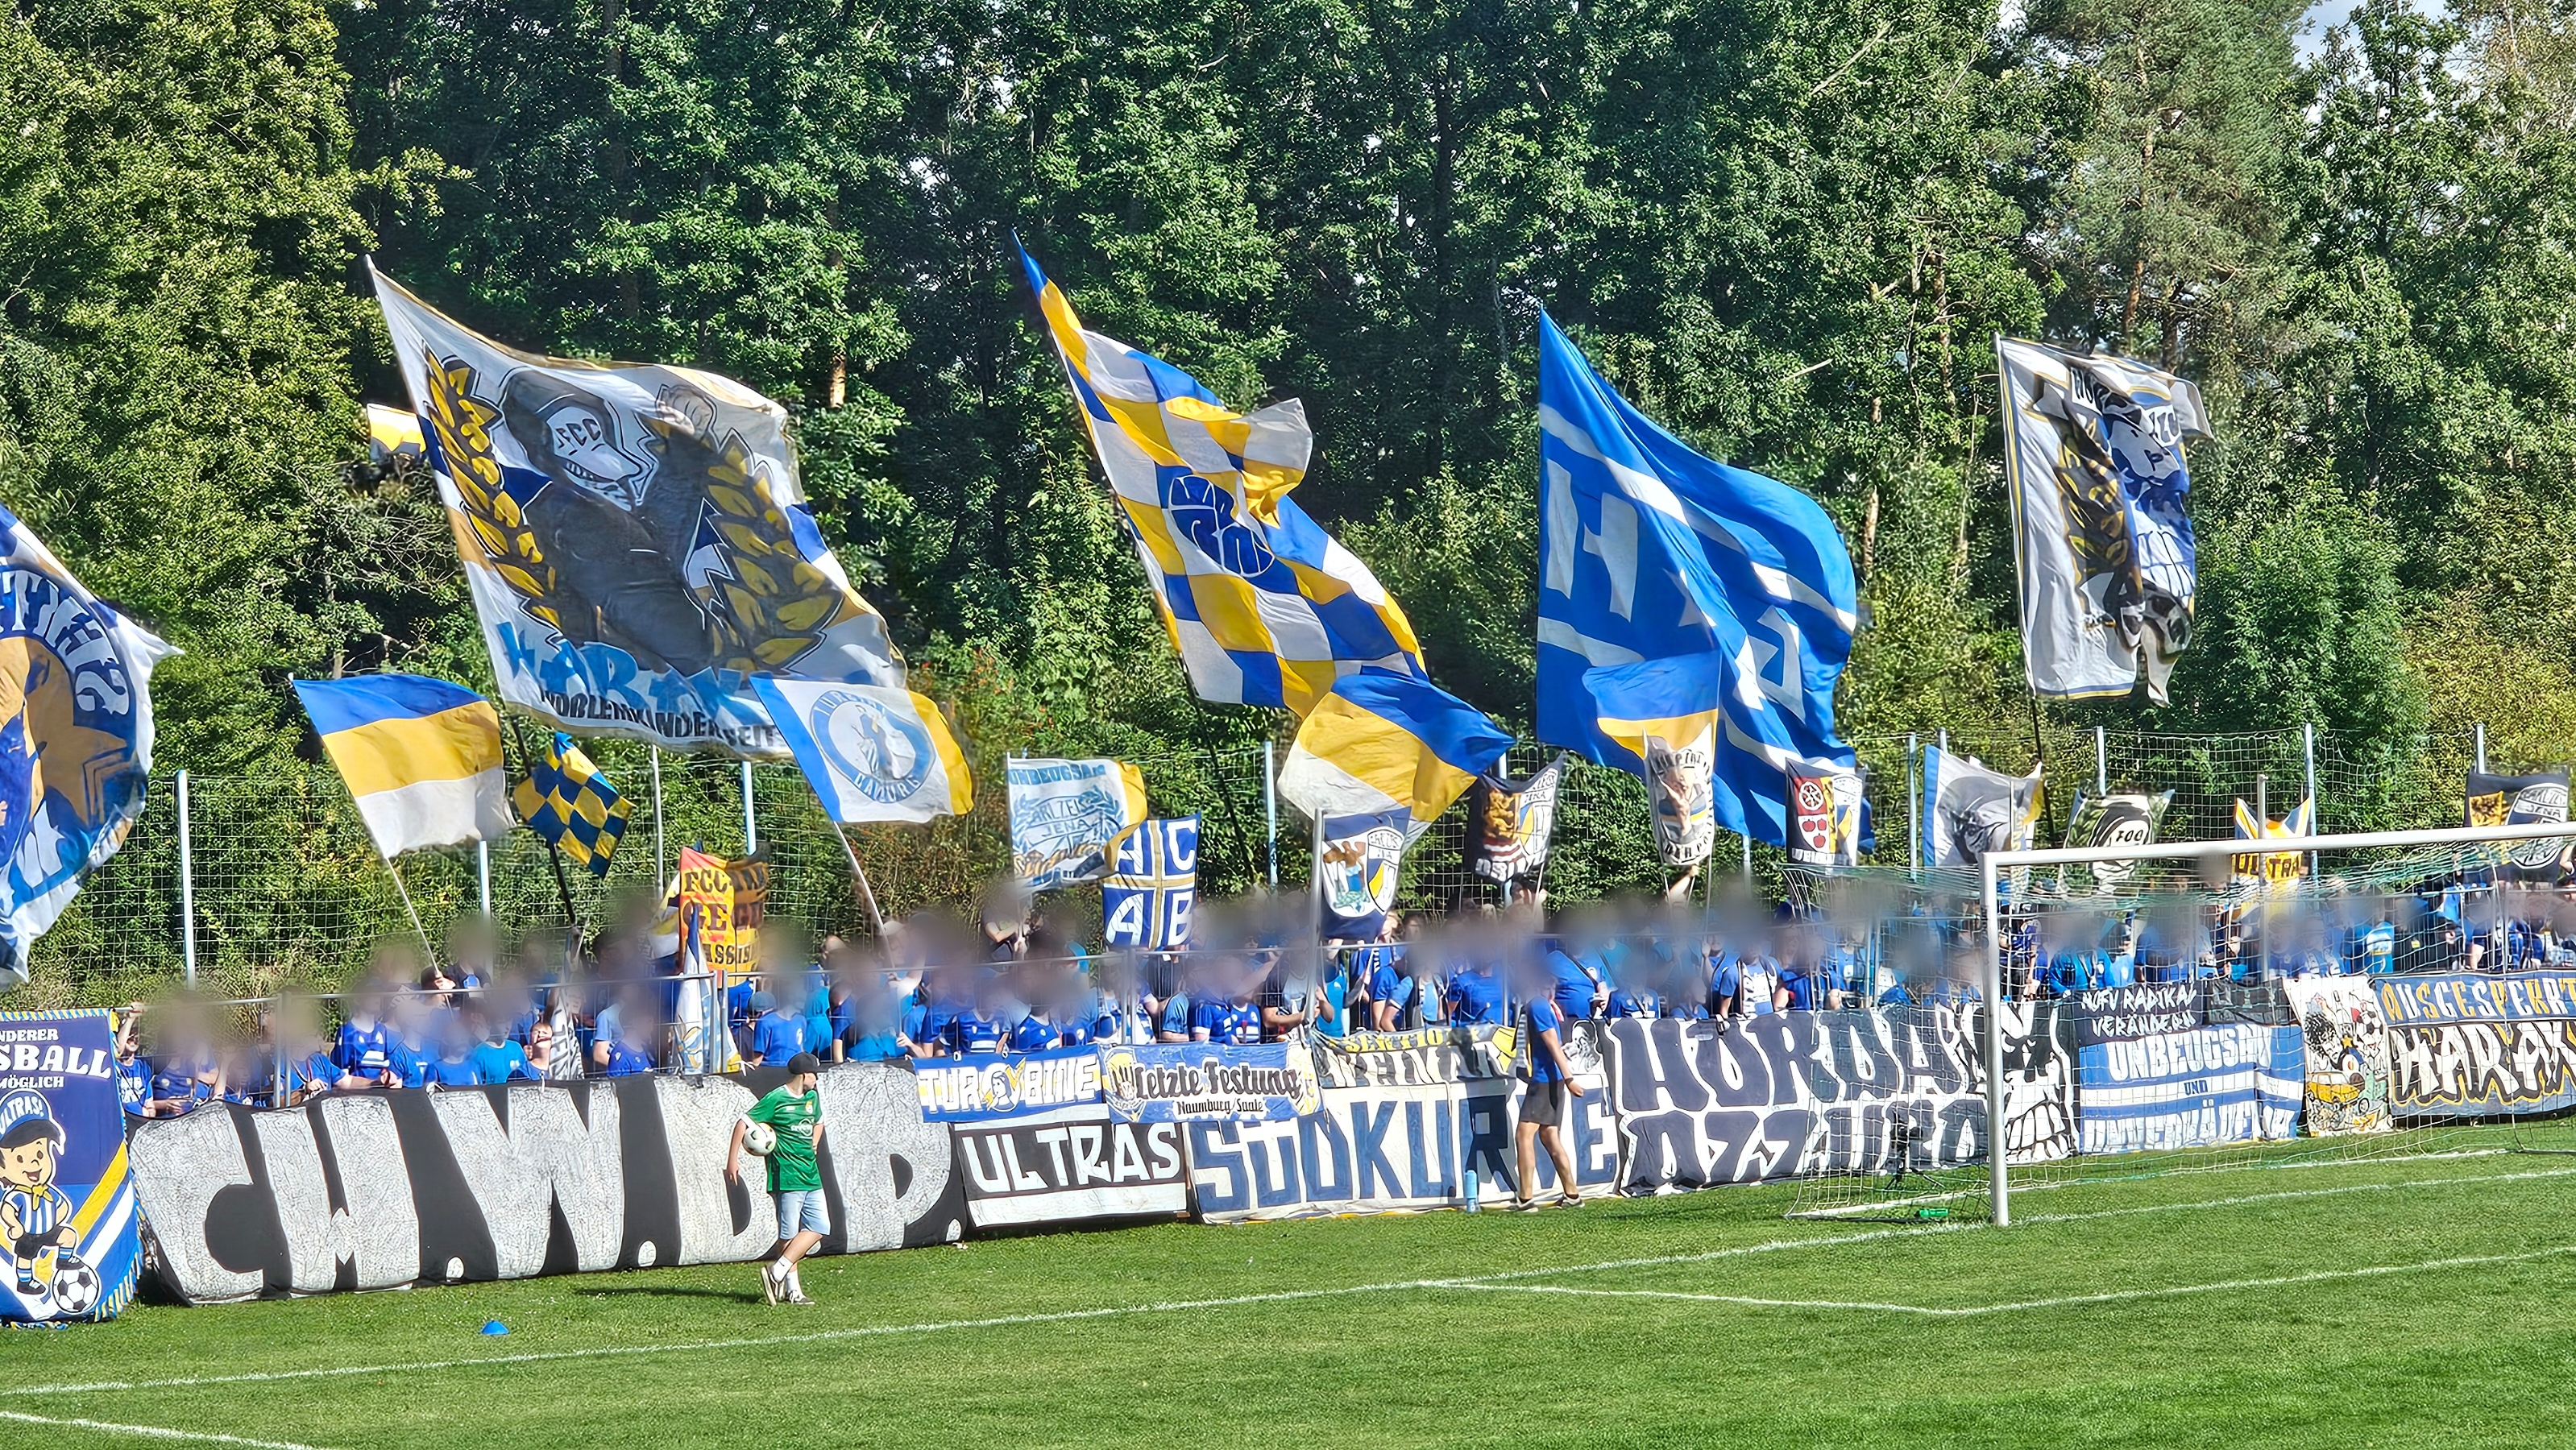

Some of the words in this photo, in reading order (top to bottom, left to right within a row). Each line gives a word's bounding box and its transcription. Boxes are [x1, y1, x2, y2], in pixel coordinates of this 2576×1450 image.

[1041, 818, 1091, 837] JENA
[1167, 819, 1197, 872] C
[684, 868, 731, 893] FCC
[1105, 893, 1144, 947] A
[1168, 890, 1194, 947] B
[1135, 1063, 1203, 1100] Letzte
[1204, 1060, 1301, 1099] Festung
[1611, 1009, 1968, 1112] HORDA
[2184, 1079, 2209, 1096] UND
[961, 1122, 1183, 1194] ULTRAS
